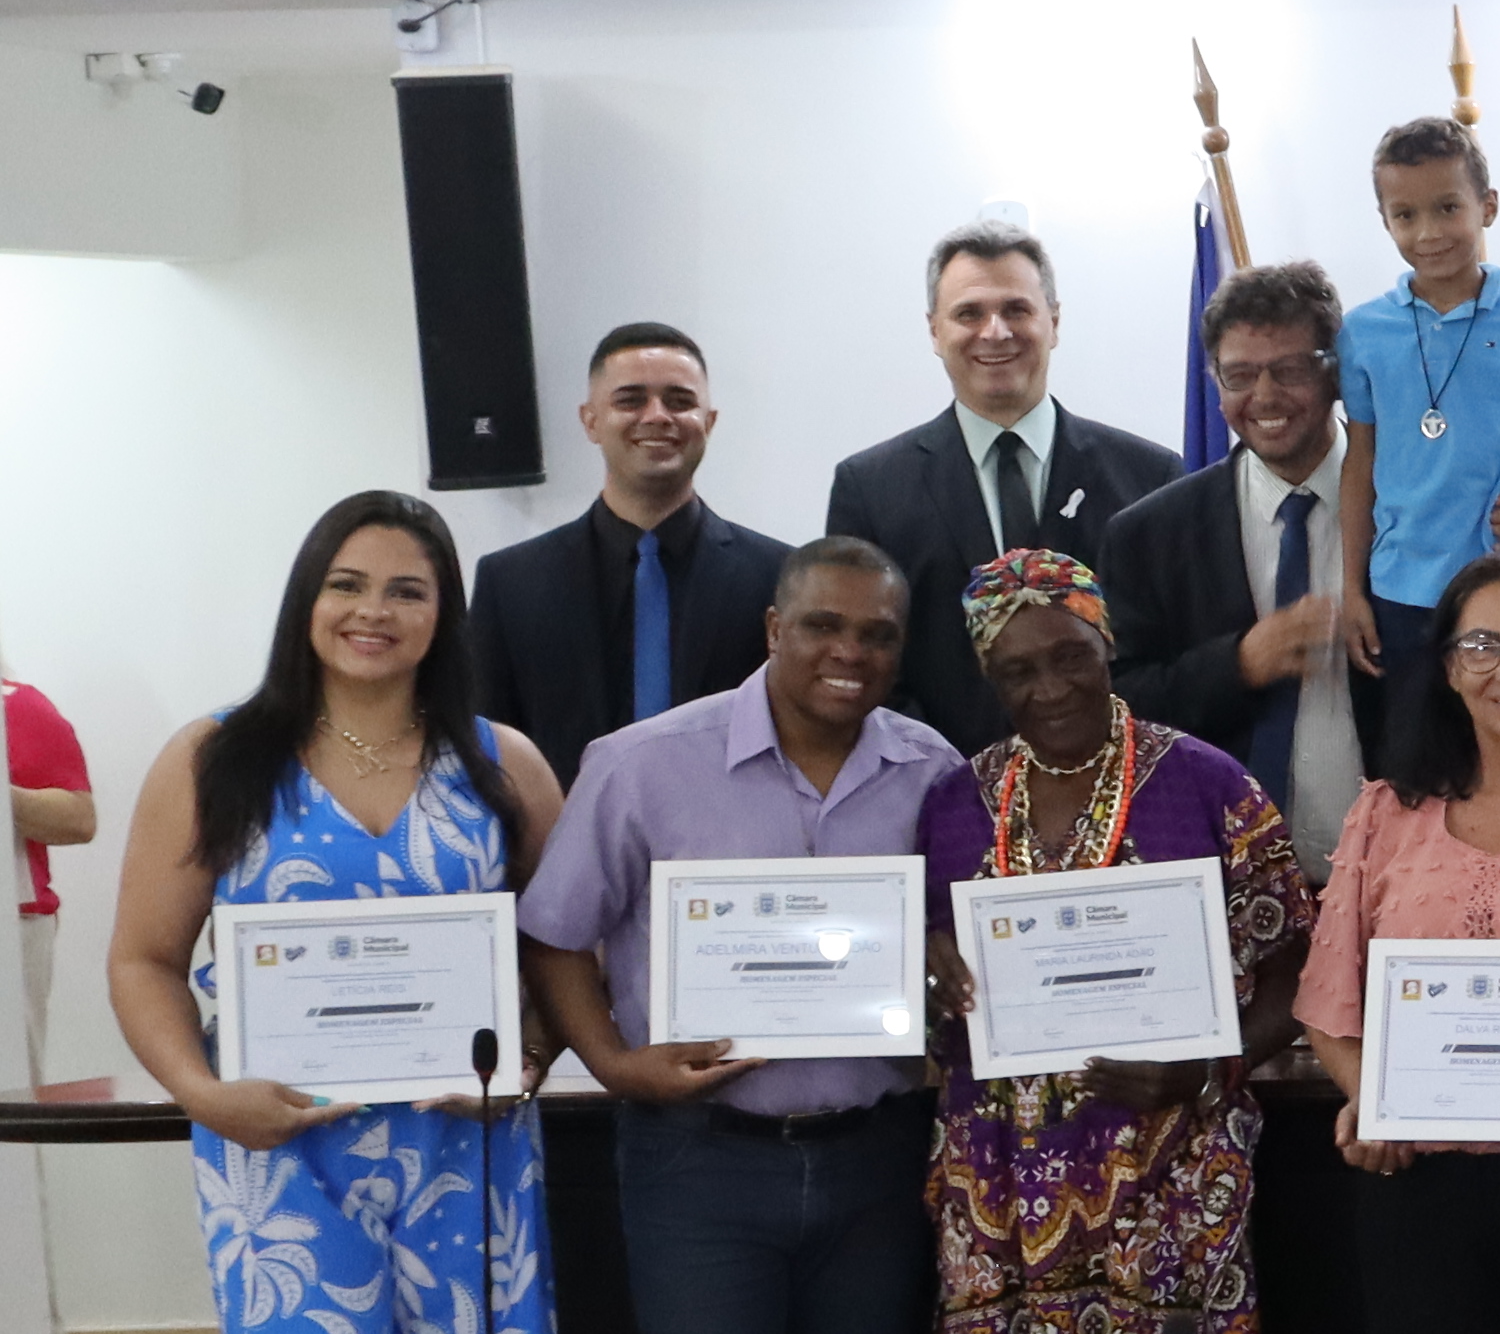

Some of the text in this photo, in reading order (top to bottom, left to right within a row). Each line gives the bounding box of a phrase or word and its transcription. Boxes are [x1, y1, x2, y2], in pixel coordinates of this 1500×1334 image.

[785, 894, 818, 902] Câmara
[785, 902, 827, 911] Municipal
[1085, 904, 1118, 915] Câmara
[1085, 911, 1128, 921] Municipal
[363, 935, 400, 945] Câmara
[363, 943, 409, 953] Municipal
[696, 939, 882, 955] ADELMIRA VENTU DÃO
[1454, 1023, 1489, 1035] DALVA
